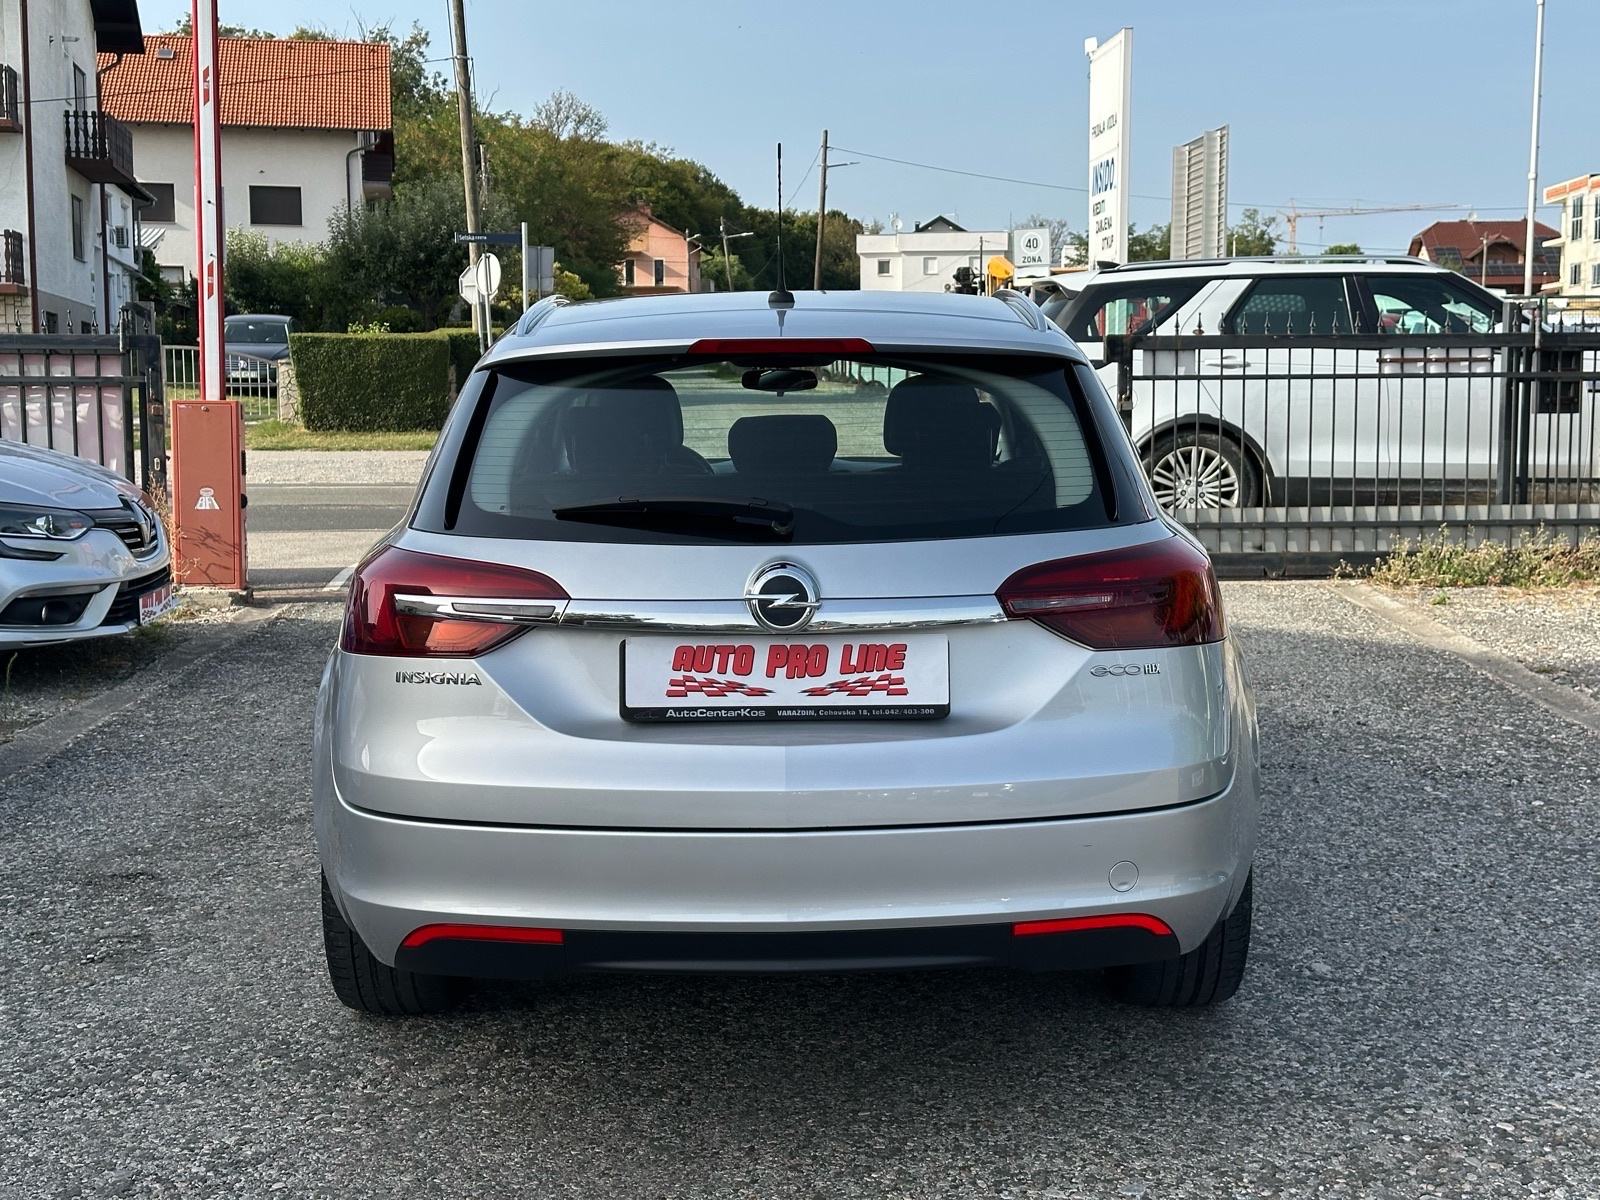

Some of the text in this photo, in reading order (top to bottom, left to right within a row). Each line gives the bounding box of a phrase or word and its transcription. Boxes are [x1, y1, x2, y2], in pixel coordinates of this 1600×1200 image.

[1026, 237, 1038, 249] 40
[672, 643, 908, 679] AUTO PRO LINE
[395, 671, 482, 686] INSIGNIA
[666, 708, 766, 718] AutoCentarKos
